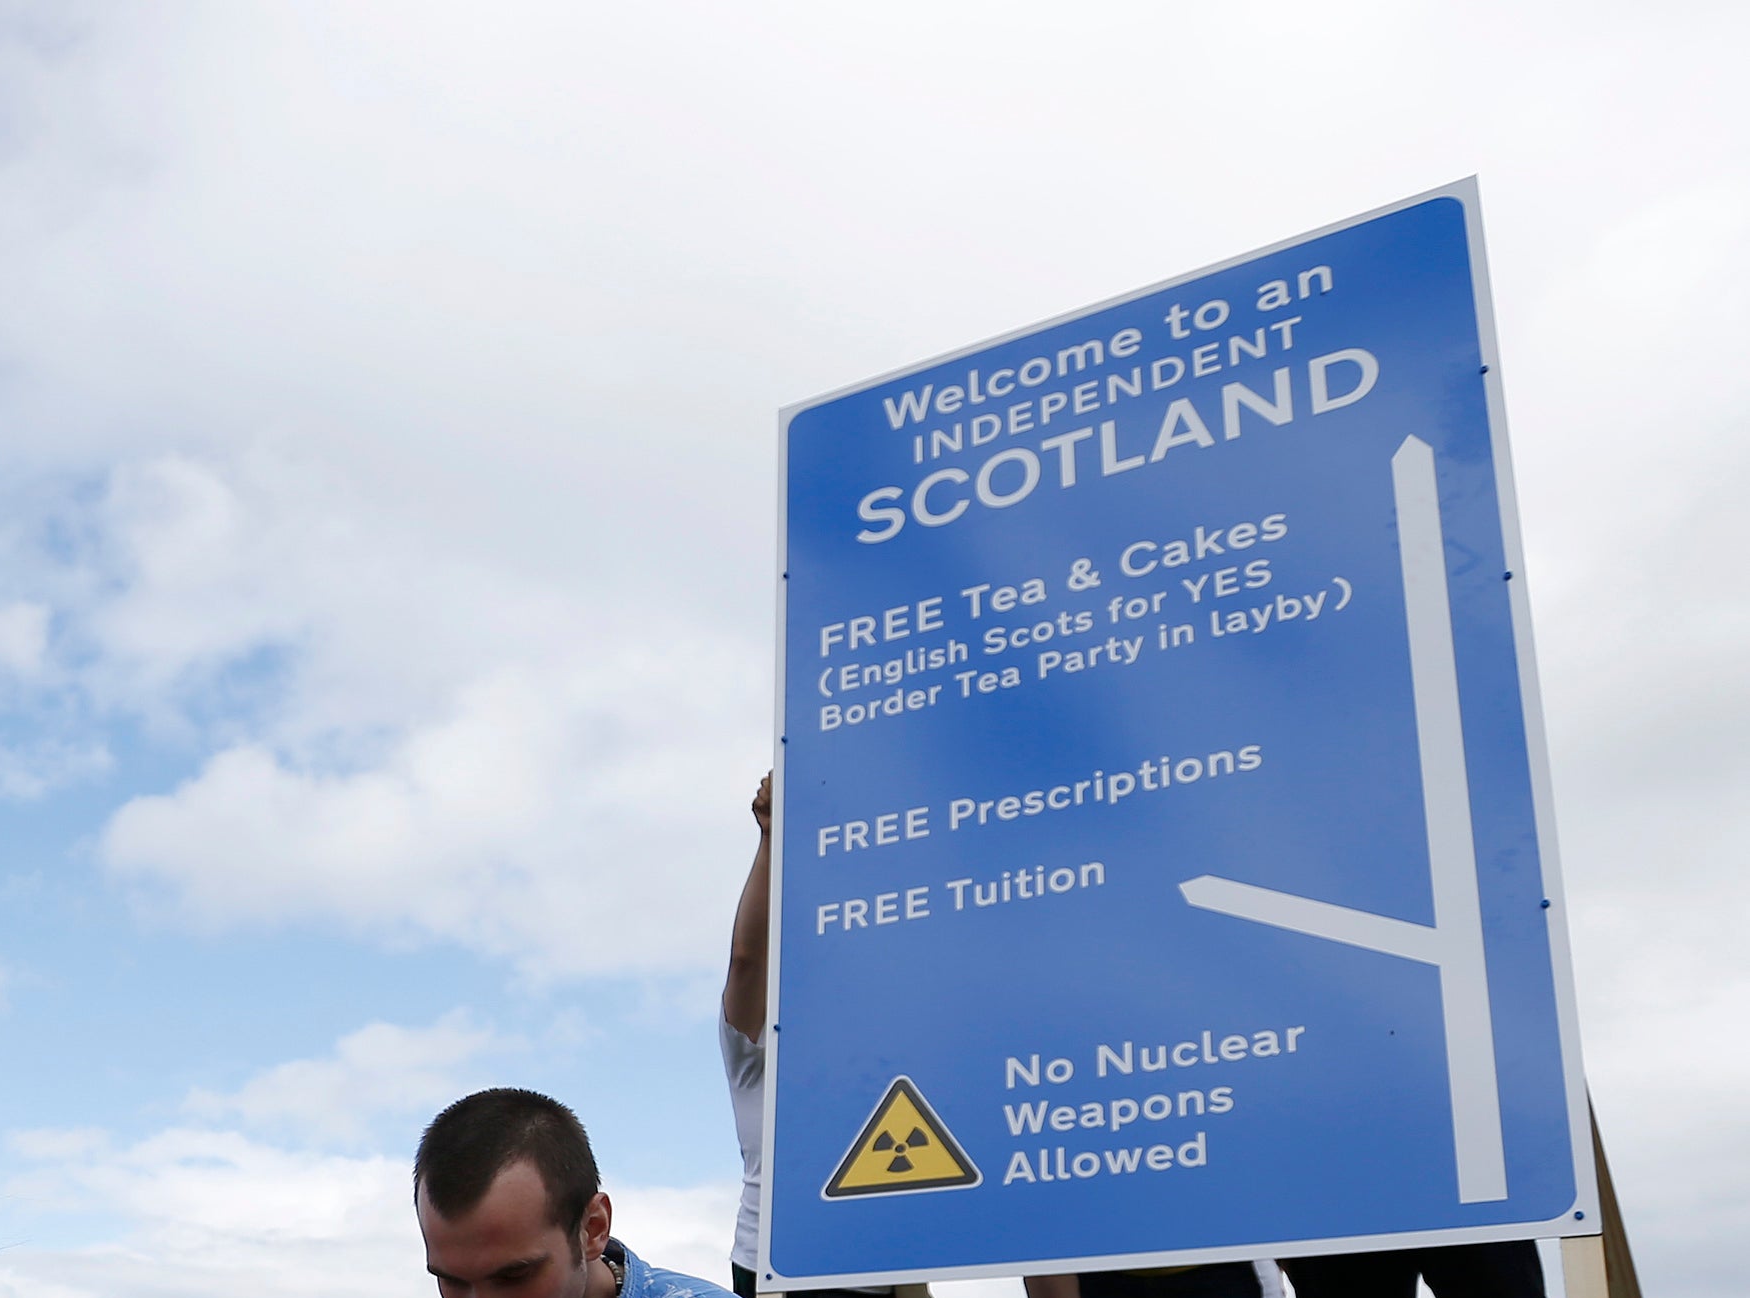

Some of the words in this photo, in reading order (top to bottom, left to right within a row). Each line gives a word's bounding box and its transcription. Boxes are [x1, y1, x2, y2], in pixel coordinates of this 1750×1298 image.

[884, 327, 1143, 431] Welcome
[1164, 299, 1230, 339] to
[1256, 265, 1333, 311] an
[914, 316, 1302, 464] INDEPENDENT
[856, 347, 1380, 545] SCOTLAND
[818, 639, 968, 698] (English
[984, 611, 1094, 654] Scots
[1107, 591, 1167, 624] for
[1182, 559, 1272, 603] YES
[819, 685, 942, 732] Border
[955, 667, 1021, 698] Tea
[1039, 635, 1144, 679] Party
[1159, 623, 1195, 650] in
[1211, 576, 1353, 637] layby)
[820, 597, 944, 658] FREE
[961, 578, 1047, 619] Tea
[1067, 557, 1102, 592] &
[1120, 513, 1288, 577] Cakes
[817, 806, 930, 857] FREE
[949, 745, 1262, 831] Prescriptions
[816, 886, 931, 936] FREE
[946, 862, 1105, 911] Tuition
[1004, 1086, 1234, 1136] Weapons
[1006, 1054, 1074, 1089] No
[1097, 1025, 1306, 1078] Nuclear
[1003, 1131, 1207, 1185] Allowed
